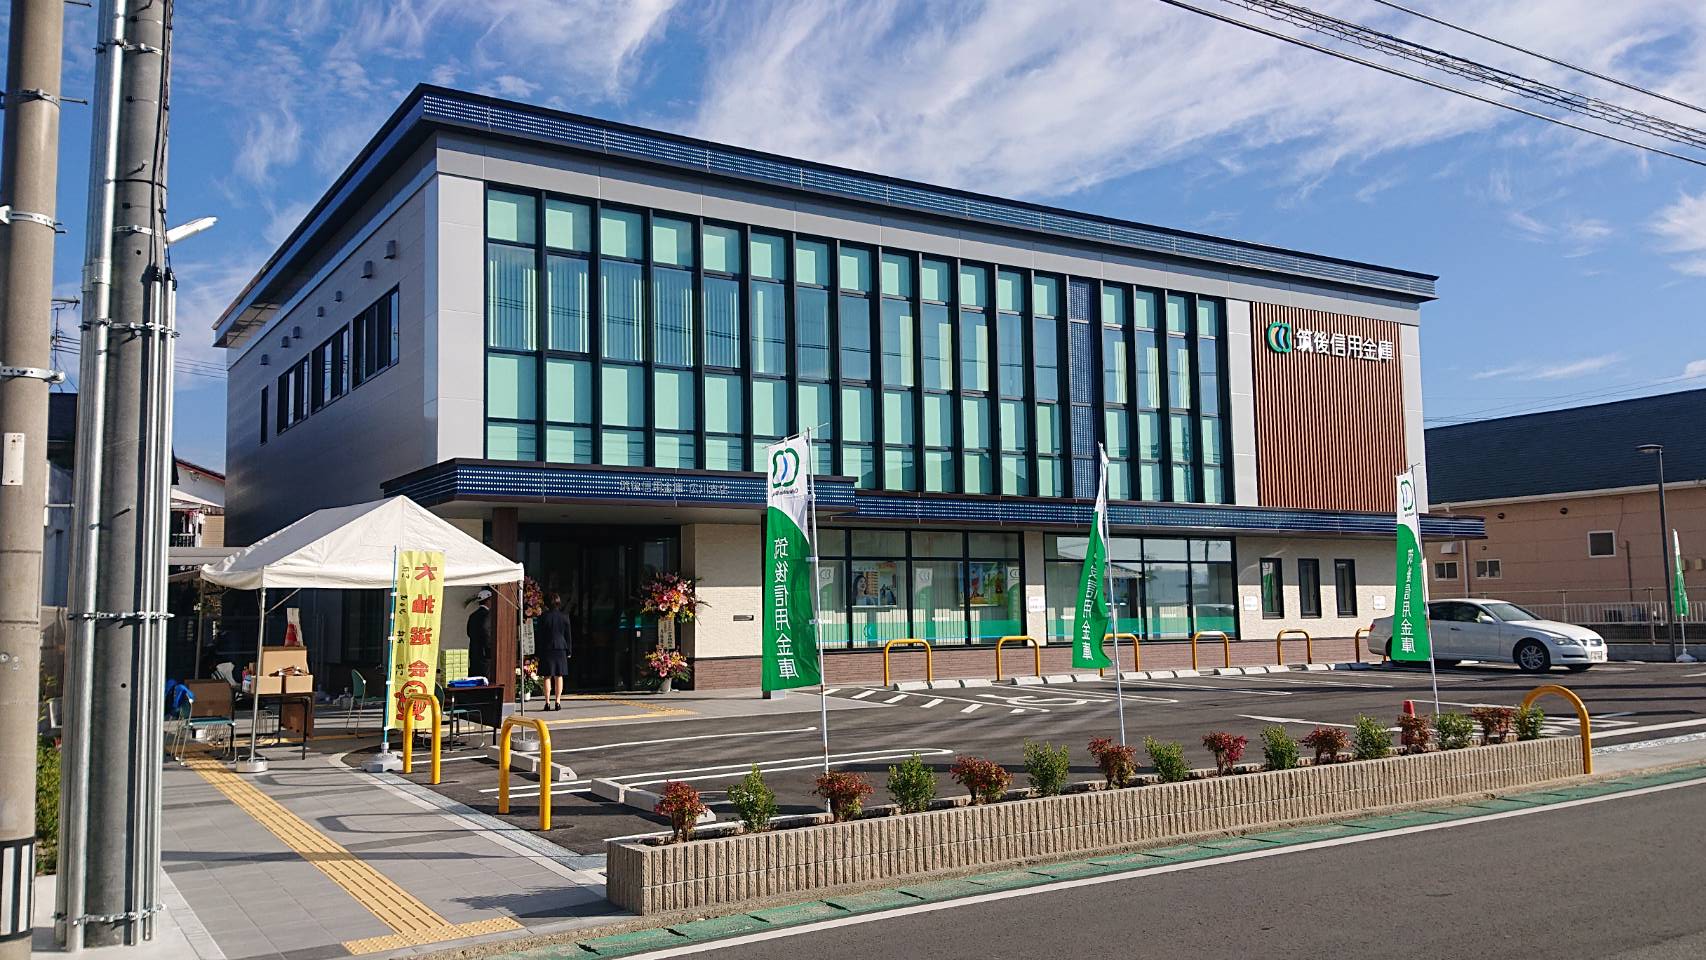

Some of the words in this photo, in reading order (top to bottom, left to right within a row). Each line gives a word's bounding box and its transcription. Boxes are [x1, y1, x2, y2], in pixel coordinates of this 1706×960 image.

[1296, 328, 1394, 361] 筑後信用金庫
[620, 480, 683, 494] 筑後信用金庫
